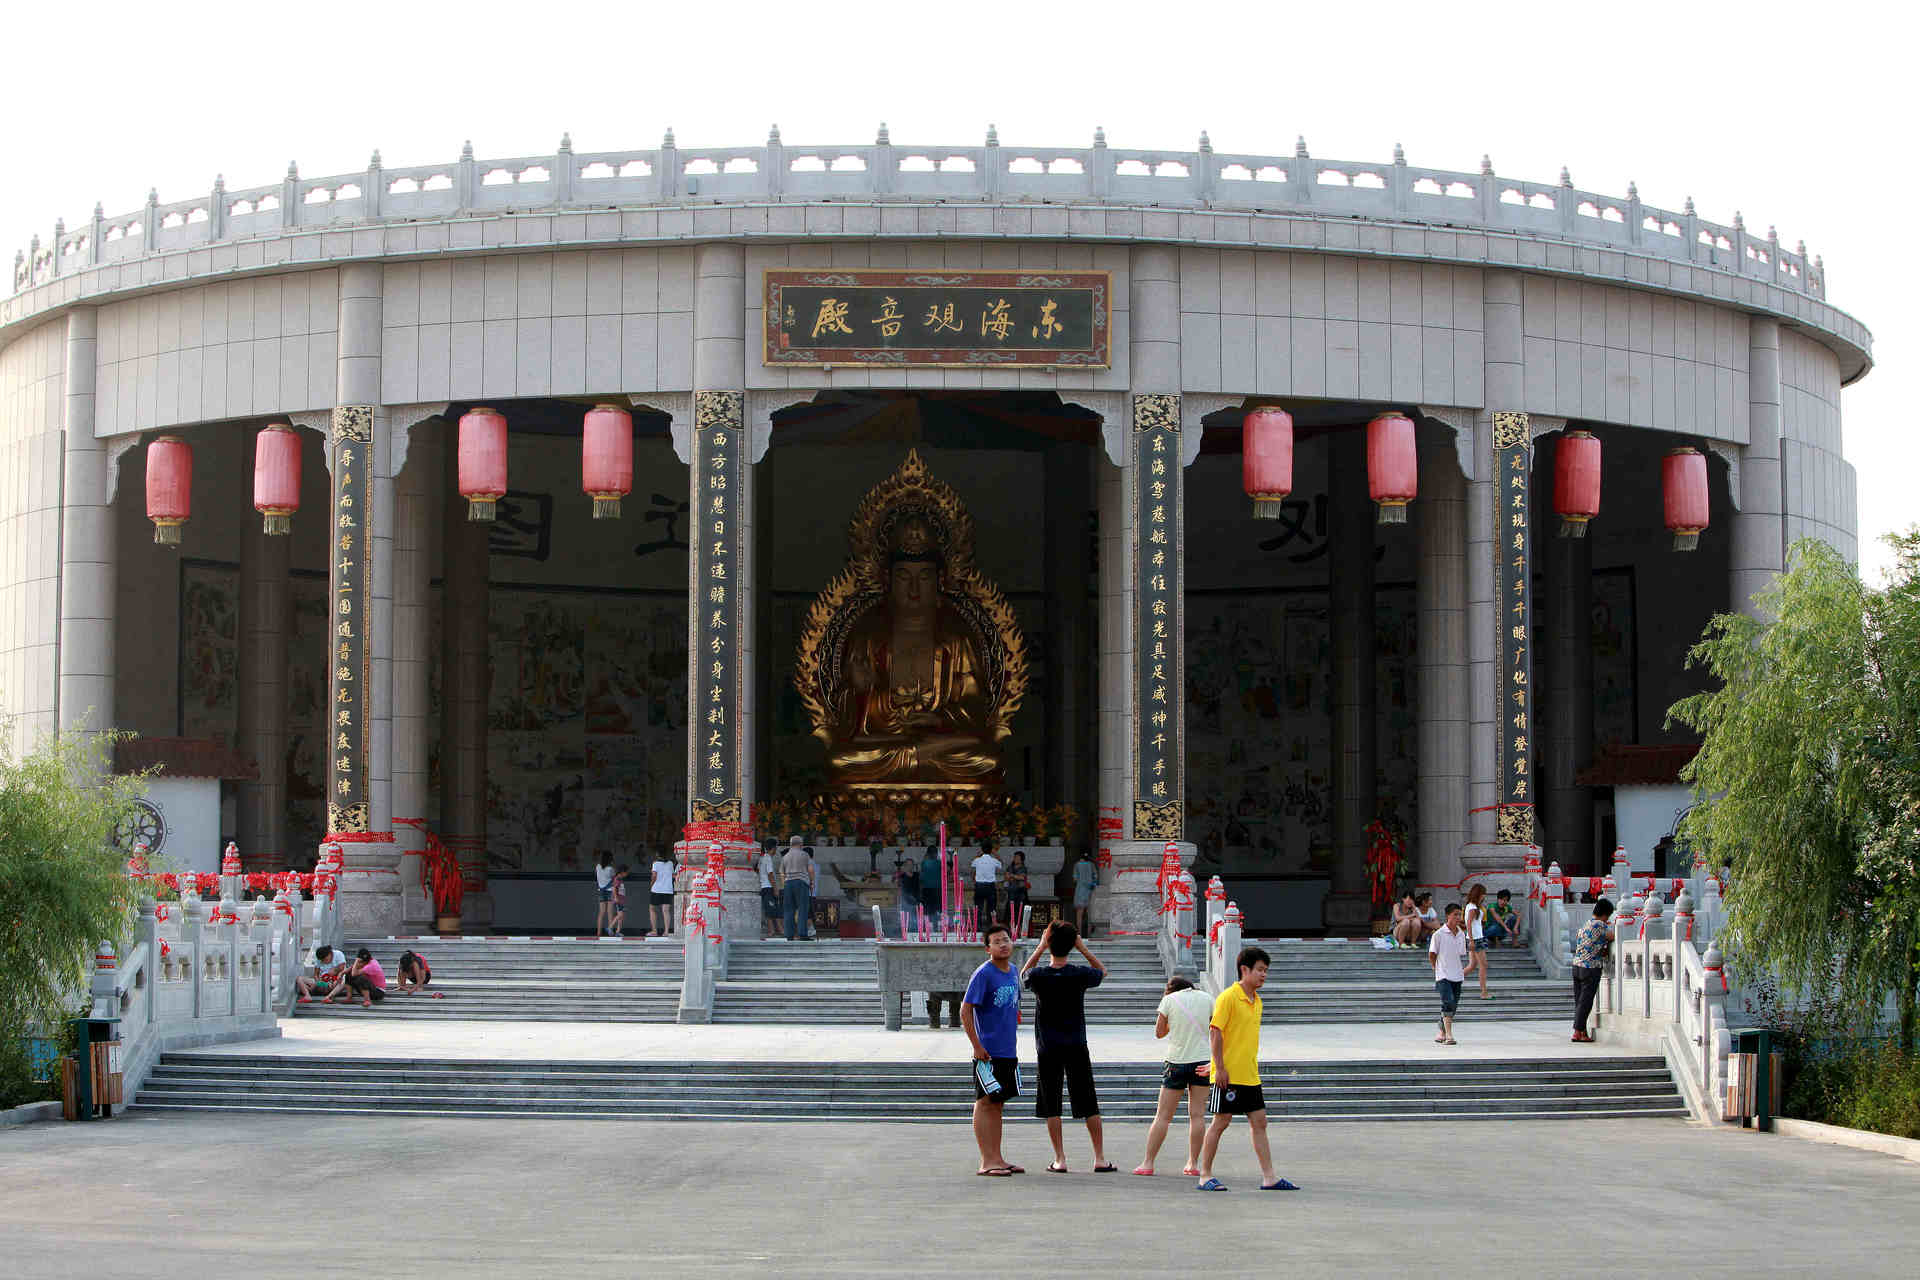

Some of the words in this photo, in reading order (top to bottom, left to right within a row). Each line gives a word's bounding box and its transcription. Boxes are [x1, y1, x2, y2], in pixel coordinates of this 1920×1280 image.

[811, 296, 1064, 341] 东海观音殿
